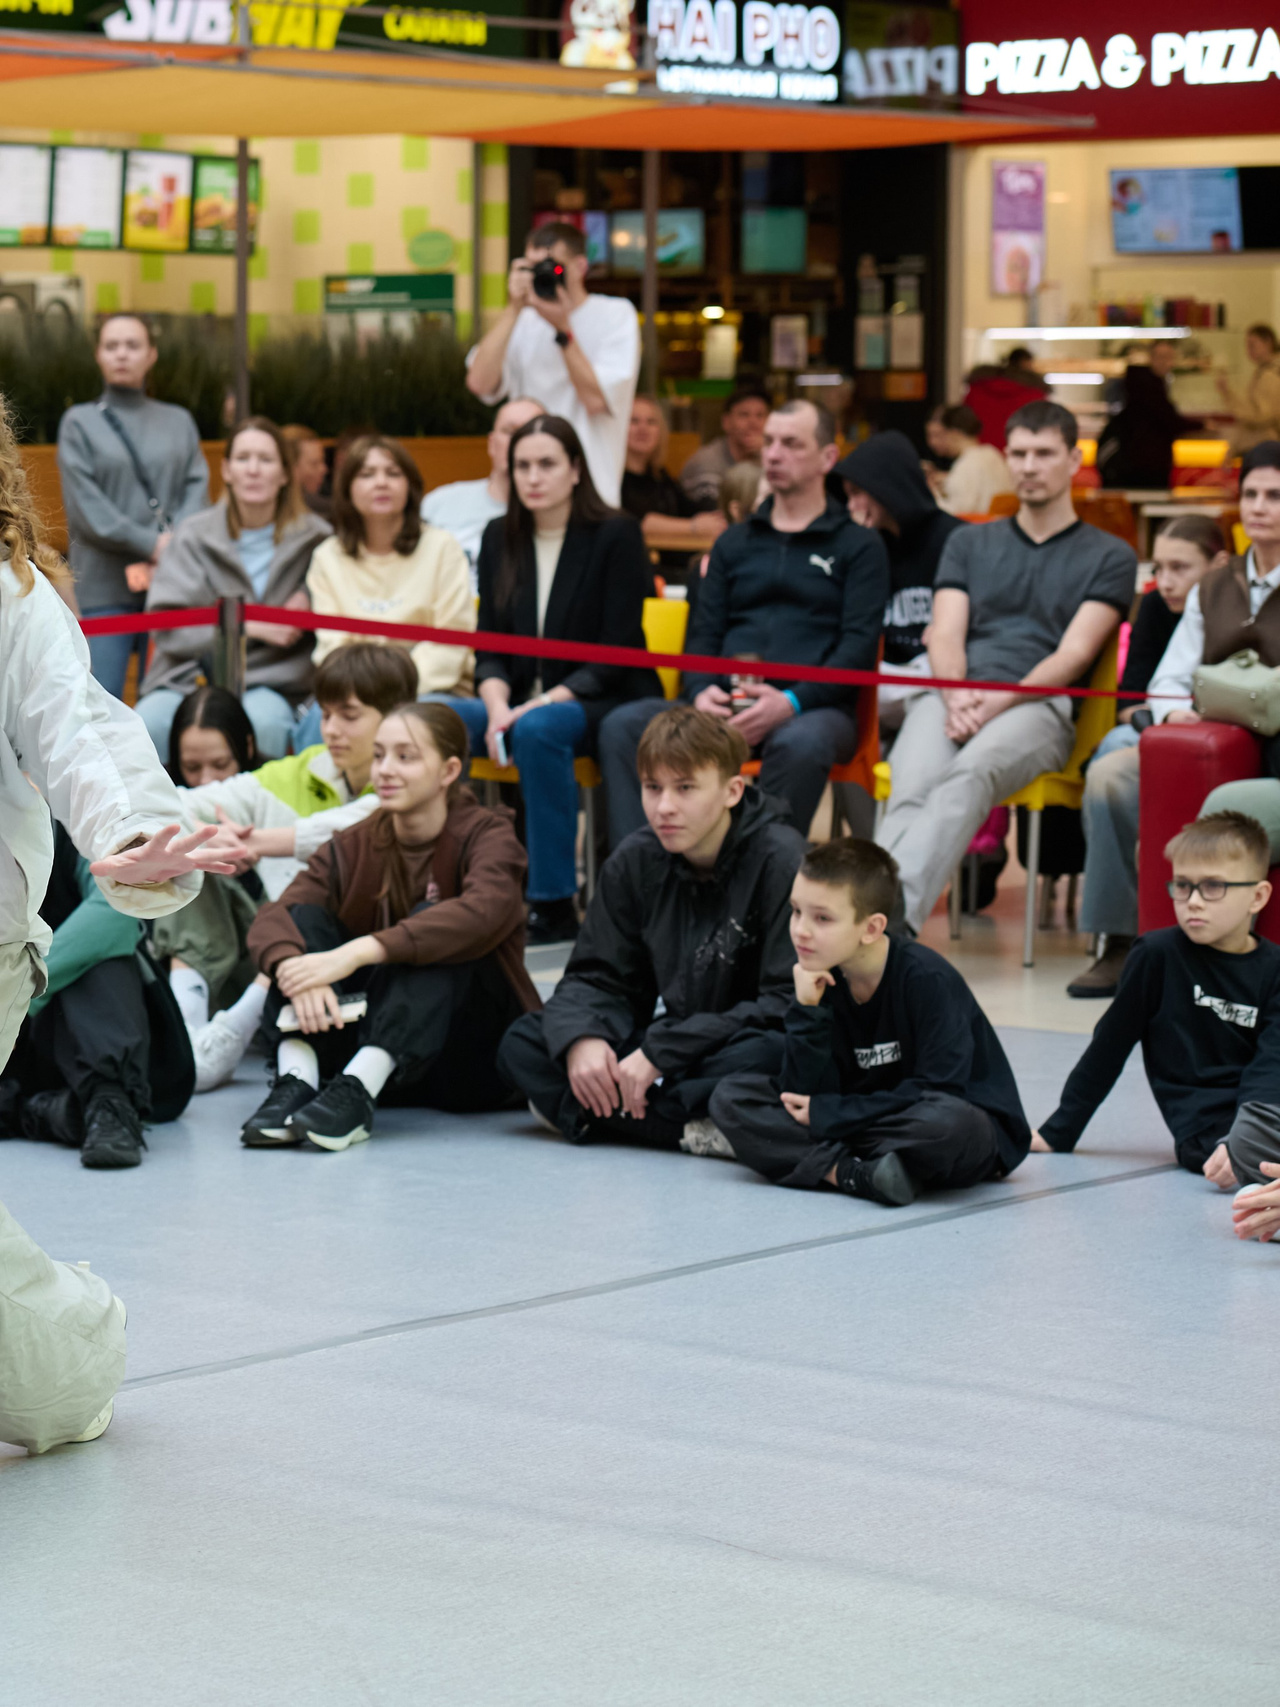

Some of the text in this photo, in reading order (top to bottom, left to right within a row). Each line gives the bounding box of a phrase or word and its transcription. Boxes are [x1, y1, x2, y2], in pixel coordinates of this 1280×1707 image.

[648, 0, 840, 72] HAI PHO
[966, 27, 1280, 95] PIZZA & PIZZA
